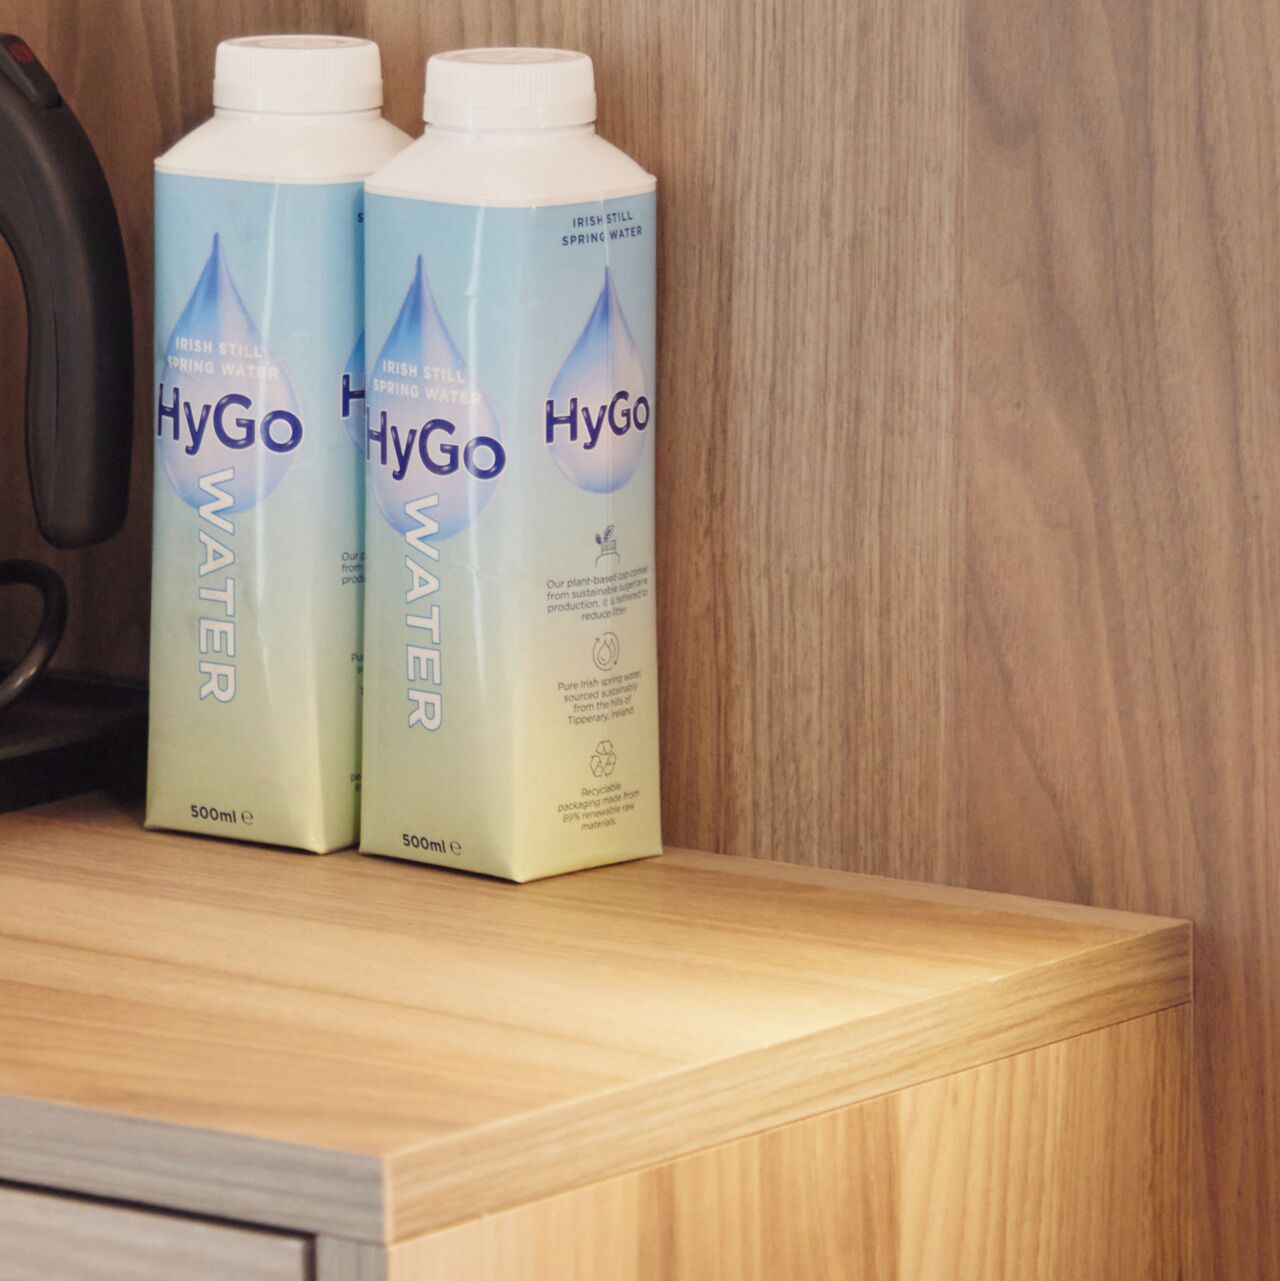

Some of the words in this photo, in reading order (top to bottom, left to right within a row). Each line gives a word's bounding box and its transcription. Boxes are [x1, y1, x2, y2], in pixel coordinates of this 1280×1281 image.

[572, 214, 603, 229] IRISH
[606, 210, 633, 225] STILL
[561, 231, 606, 247] SPRING
[608, 225, 643, 241] WATER
[175, 336, 213, 354] IRISH
[219, 341, 263, 359] STILL
[166, 355, 215, 375] SPRING
[220, 362, 280, 380] WATER
[382, 359, 418, 378] IRISH
[423, 366, 465, 384] STILL
[372, 378, 420, 399] SPRING
[424, 386, 481, 406] WATER
[157, 383, 303, 456] HyGo
[544, 389, 651, 451] HyGo
[367, 406, 507, 480] HyGo
[198, 466, 237, 704] WATER
[546, 579, 565, 590] Our
[567, 574, 617, 589] plant-based
[547, 591, 570, 601] from
[571, 585, 618, 599] sustainable
[404, 492, 443, 733] WATER
[547, 600, 600, 614] production.
[581, 609, 611, 621] reduce
[558, 681, 579, 692] Pure
[580, 677, 599, 689] Irish
[600, 675, 623, 687] spring
[564, 691, 600, 703] sourced
[573, 703, 595, 713] from
[596, 701, 610, 711] the
[624, 694, 632, 705] of
[581, 782, 622, 797] Recyclable
[557, 800, 601, 813] packaging
[602, 793, 622, 804] made
[623, 789, 640, 800] from
[582, 805, 622, 819] renewable
[622, 802, 635, 812] raw
[190, 804, 237, 825] 500ml
[402, 833, 447, 854] 500ml
